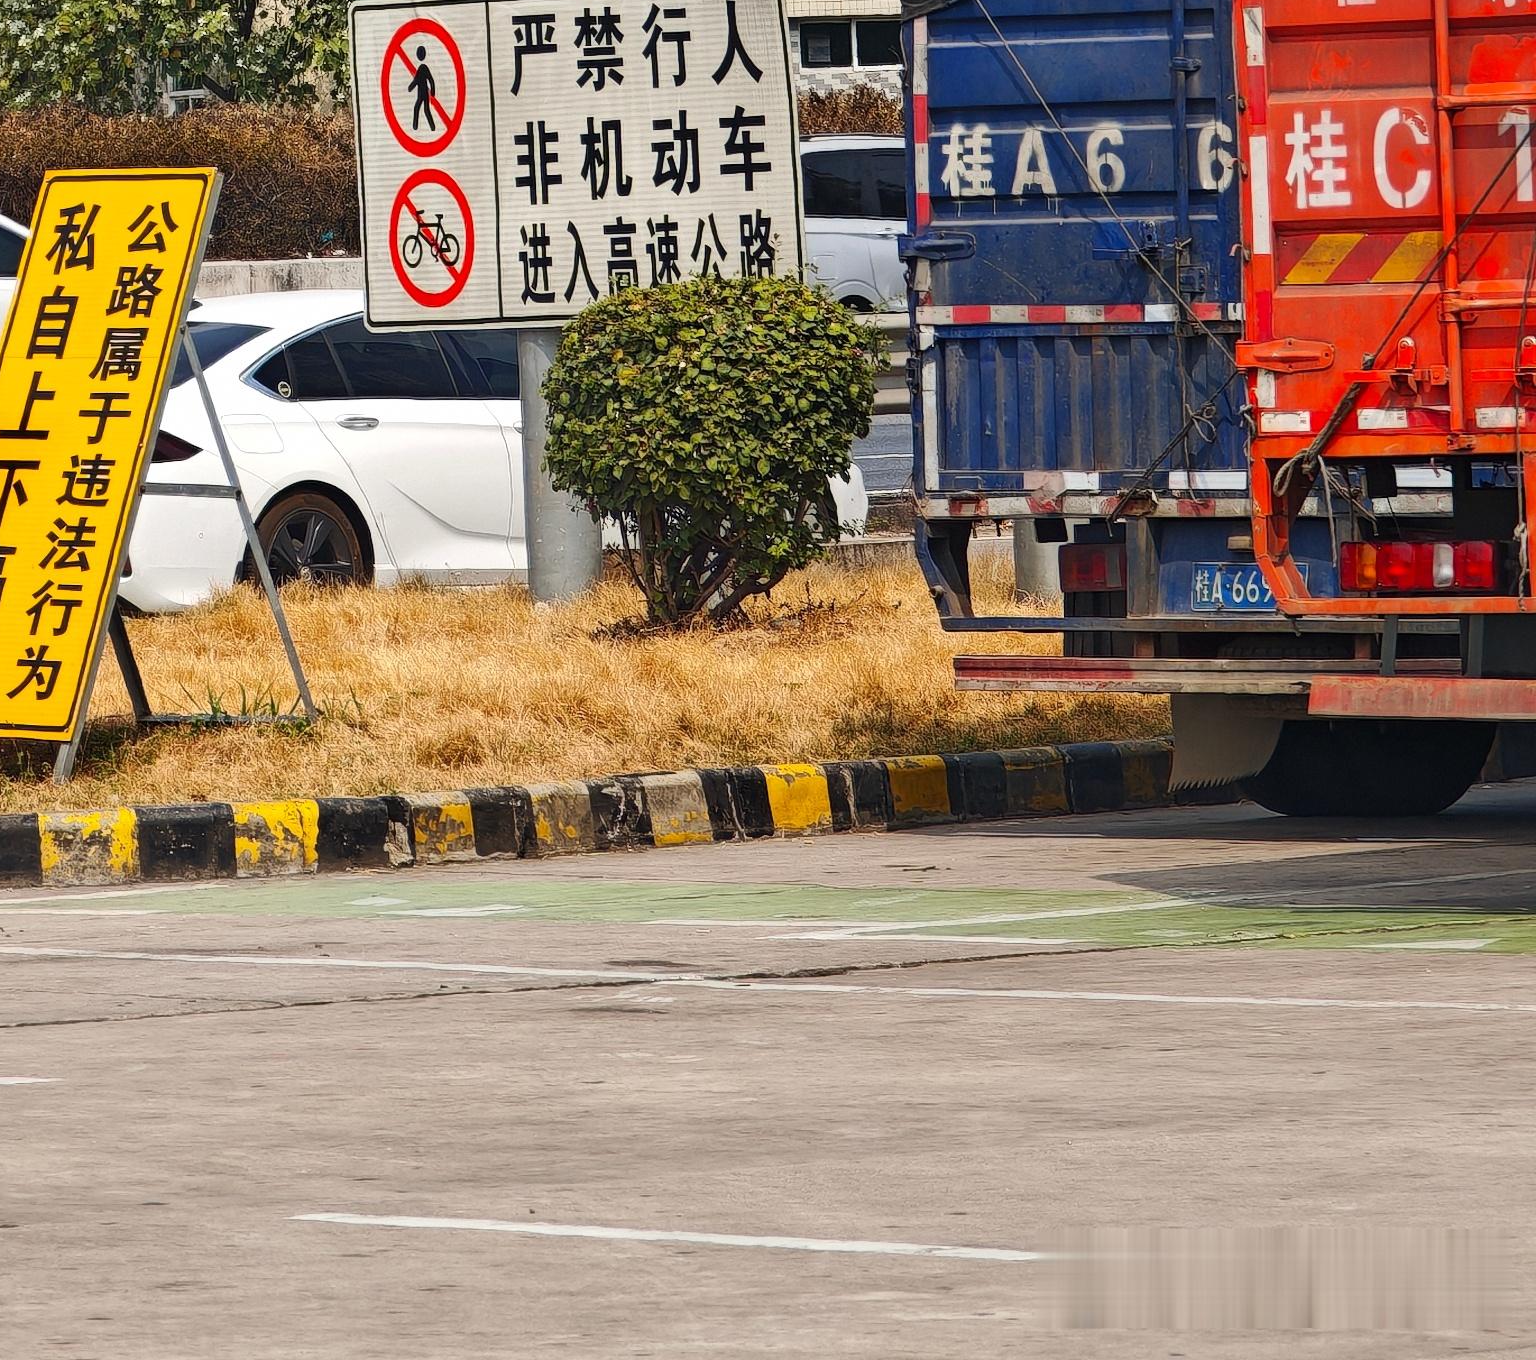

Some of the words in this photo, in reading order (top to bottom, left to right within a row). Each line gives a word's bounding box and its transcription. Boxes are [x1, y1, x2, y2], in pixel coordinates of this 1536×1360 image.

[510, 0, 764, 96] 严禁行人
[513, 105, 772, 206] 非机动车
[518, 208, 776, 306] 进入高速公路
[7, 200, 179, 702] 公路属于违法行为
